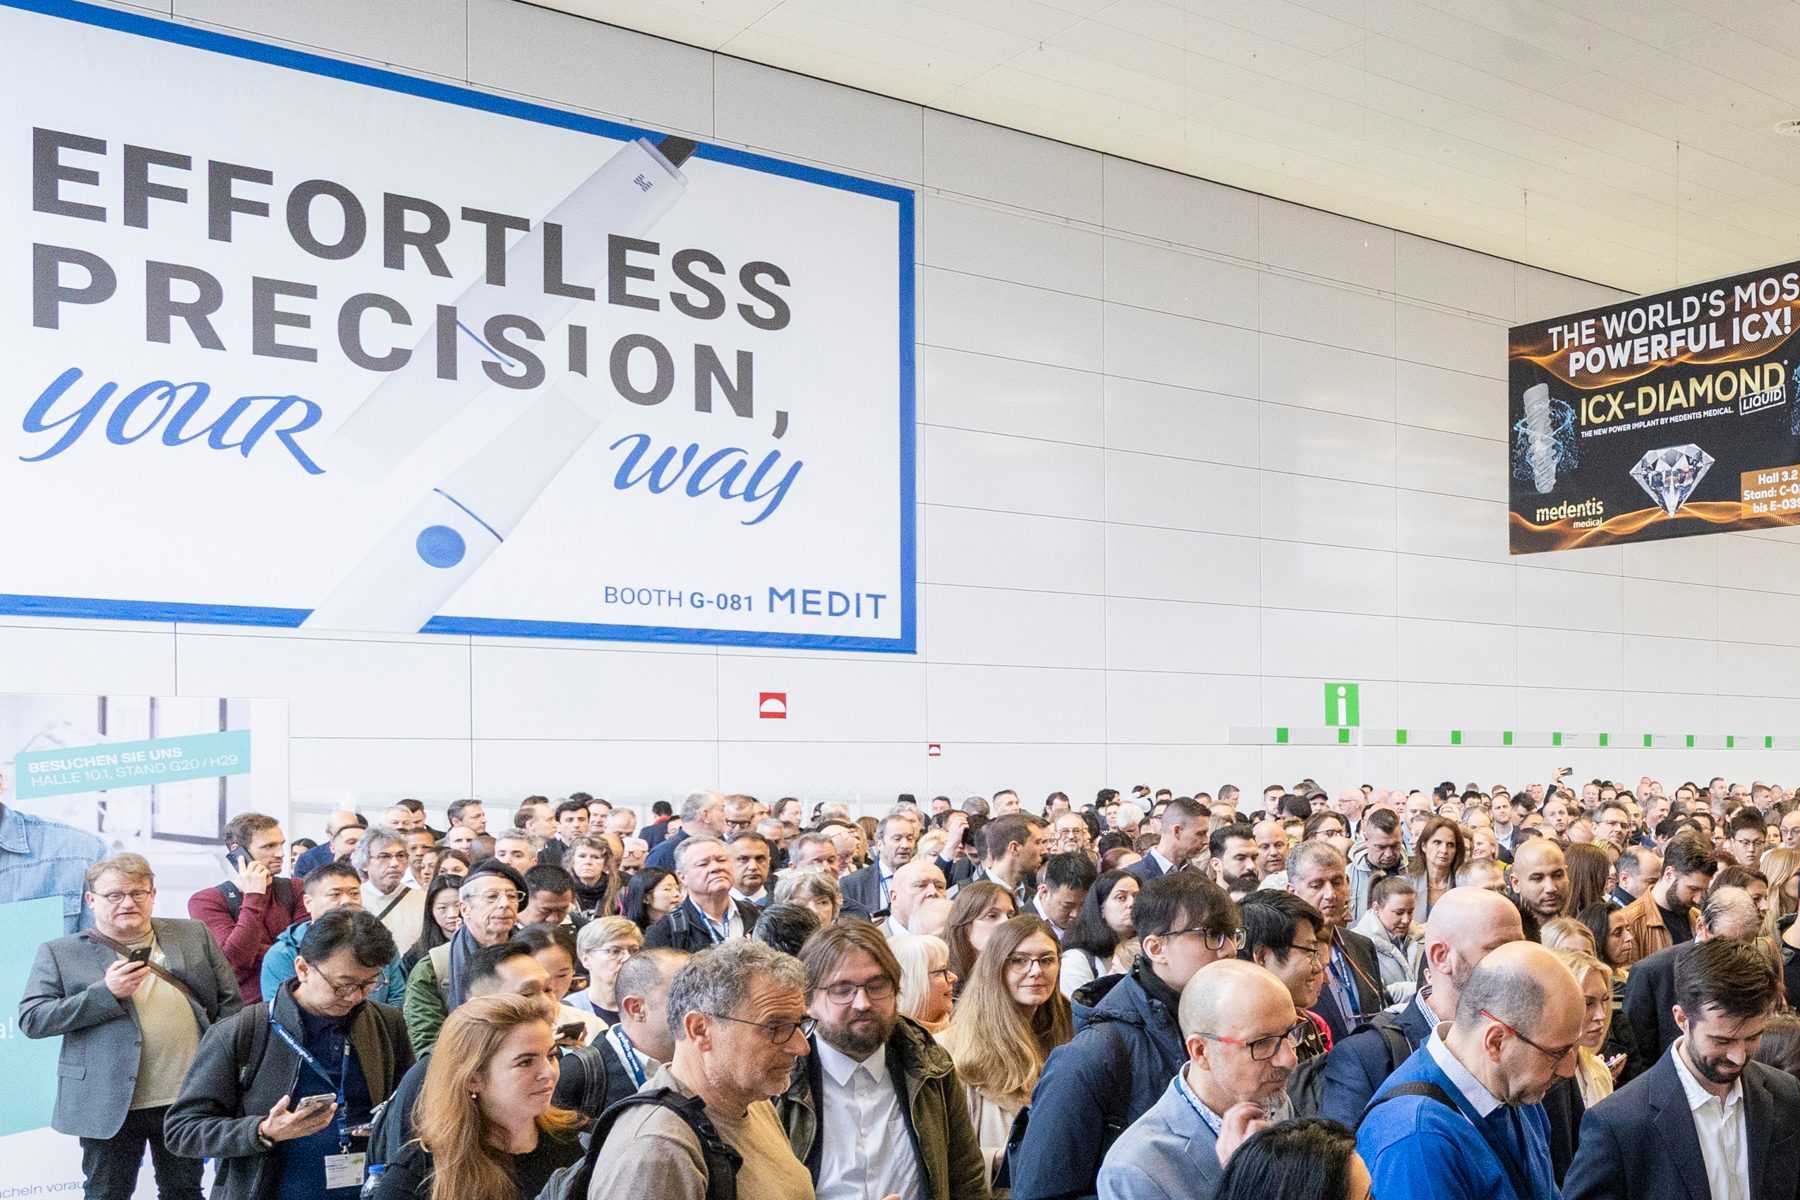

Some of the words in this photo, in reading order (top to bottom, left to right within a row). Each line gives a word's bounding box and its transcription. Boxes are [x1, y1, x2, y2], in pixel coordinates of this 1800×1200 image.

[32, 126, 791, 331] EFFORTLESS
[1548, 319, 1595, 352] THE
[1601, 289, 1726, 340] WORLD'S
[32, 242, 790, 440] PRECISION,
[1568, 324, 1727, 377] POWERFUL
[1732, 306, 1792, 345] ICX!
[1580, 362, 1786, 426] ICX-DIAMOND
[1743, 388, 1783, 411] LIQUID
[1608, 423, 1631, 435] POWER
[1669, 411, 1702, 424] MEDENTIS
[609, 432, 804, 526] way
[1758, 473, 1779, 485] Hall
[1781, 469, 1799, 483] 3.2
[1743, 486, 1777, 500] Stand:
[1536, 497, 1604, 523] medentis
[1753, 500, 1768, 514] bis
[1573, 517, 1604, 529] medical
[605, 586, 683, 608] BOOTH
[690, 591, 753, 612] G-081
[768, 587, 887, 619] MEDIT
[28, 754, 118, 773] BESUCHEN
[121, 750, 146, 763] SIE
[149, 747, 182, 759] UNS
[31, 772, 80, 787] HALLE
[115, 762, 166, 778] STAND
[169, 759, 200, 772] G20
[46, 1180, 83, 1193] vorau
